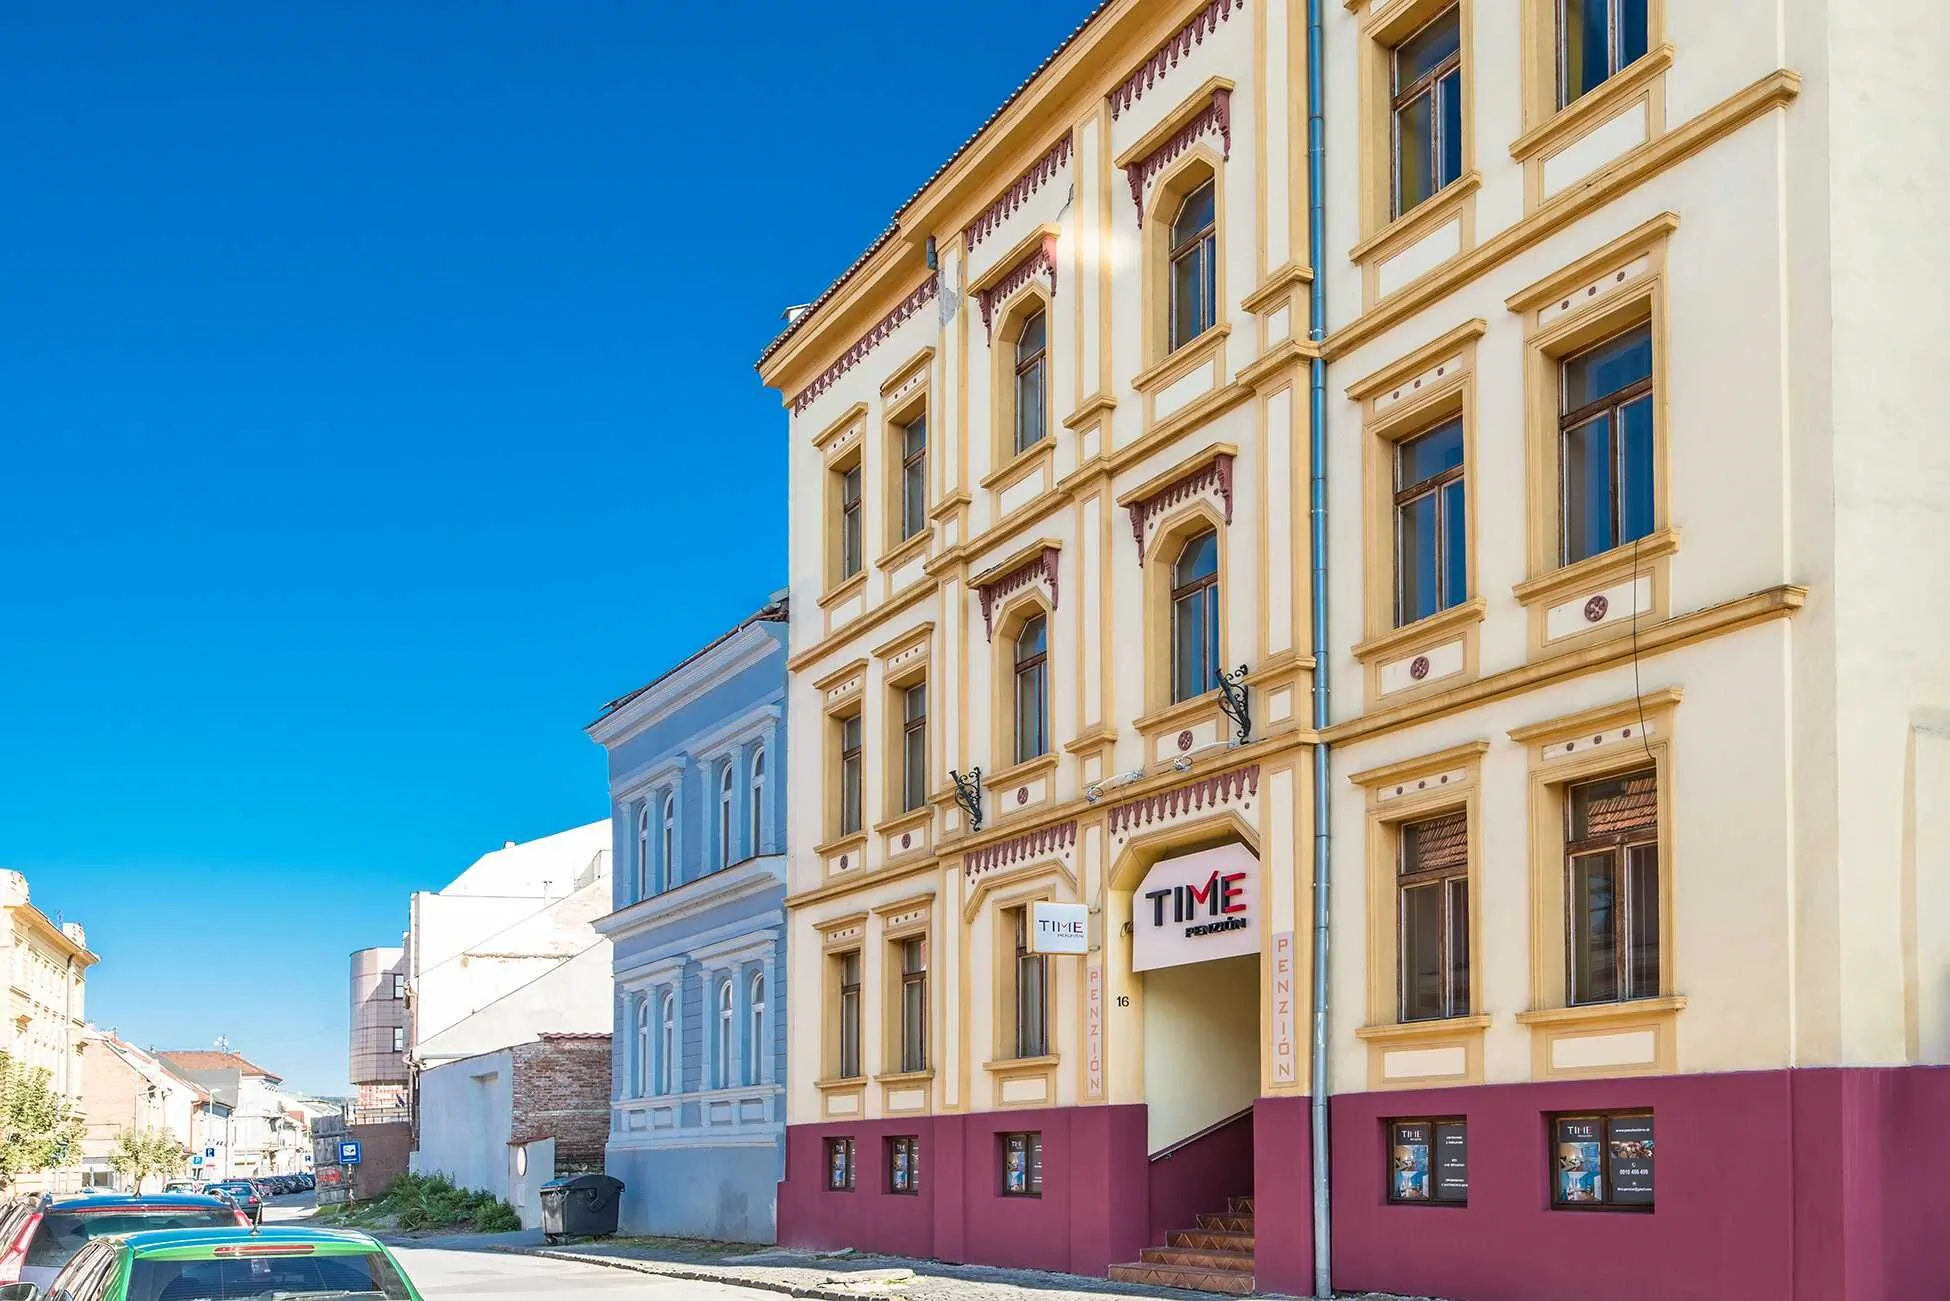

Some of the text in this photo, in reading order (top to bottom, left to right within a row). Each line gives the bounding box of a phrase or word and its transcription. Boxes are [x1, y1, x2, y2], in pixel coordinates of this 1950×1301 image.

[1145, 870, 1247, 926] TIME
[1038, 919, 1083, 933] TIME
[1117, 996, 1130, 1007] 16
